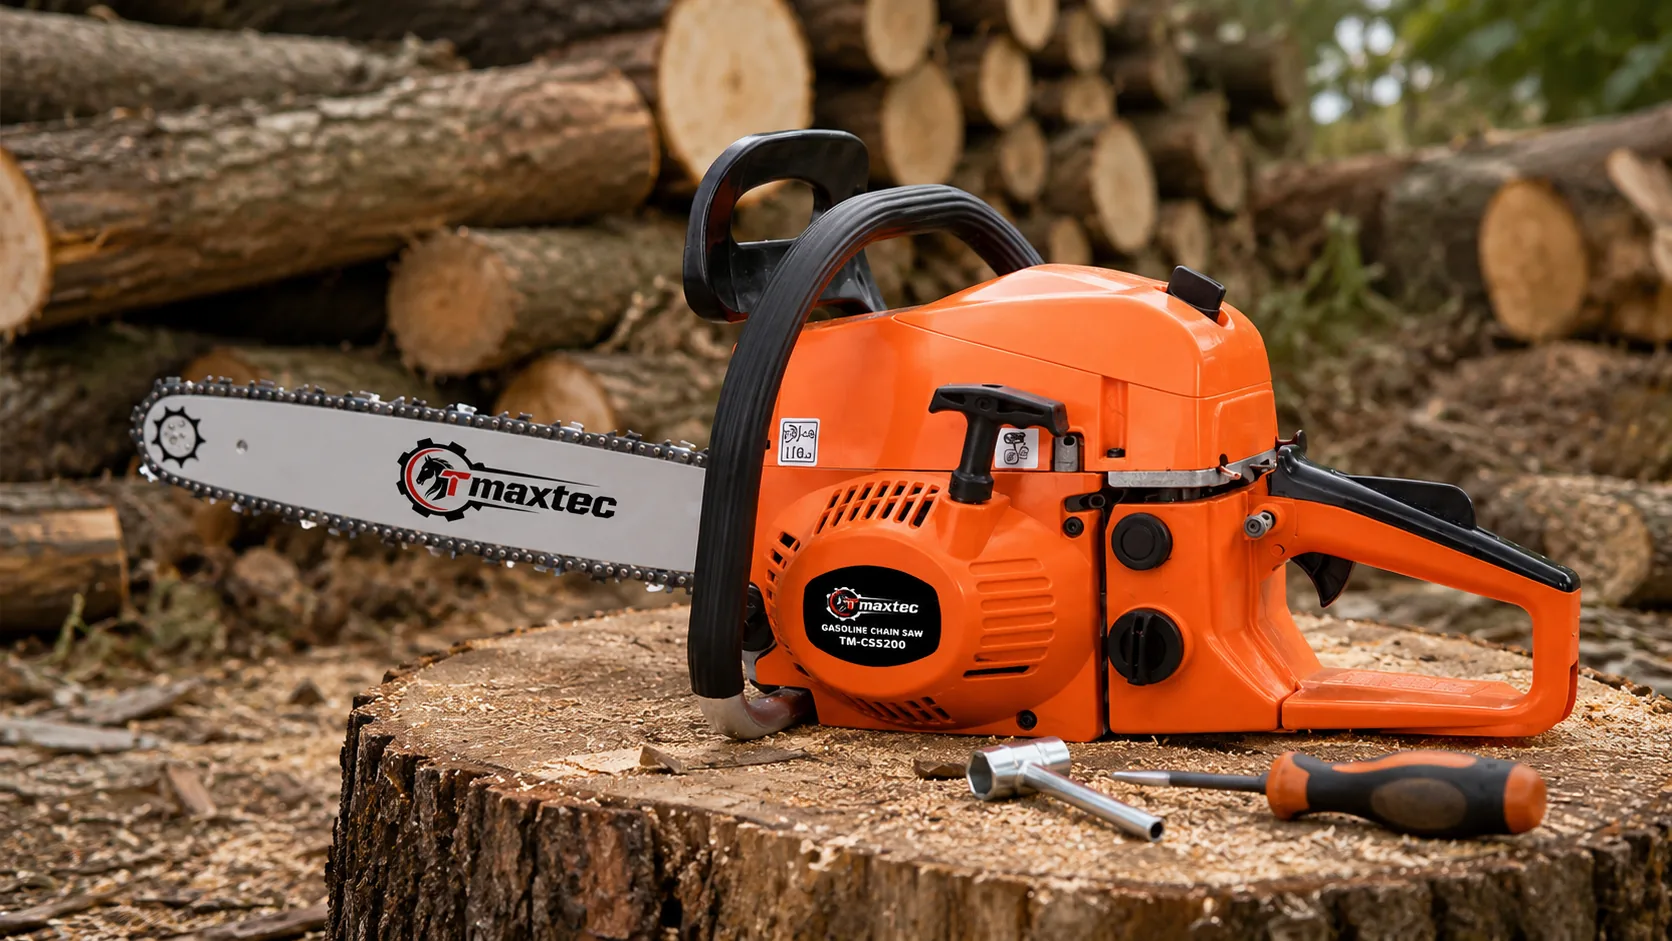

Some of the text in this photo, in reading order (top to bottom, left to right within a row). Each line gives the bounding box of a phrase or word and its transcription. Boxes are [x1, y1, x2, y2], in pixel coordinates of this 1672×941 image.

[821, 624, 924, 638] GASOLINE CHAIN SAW
